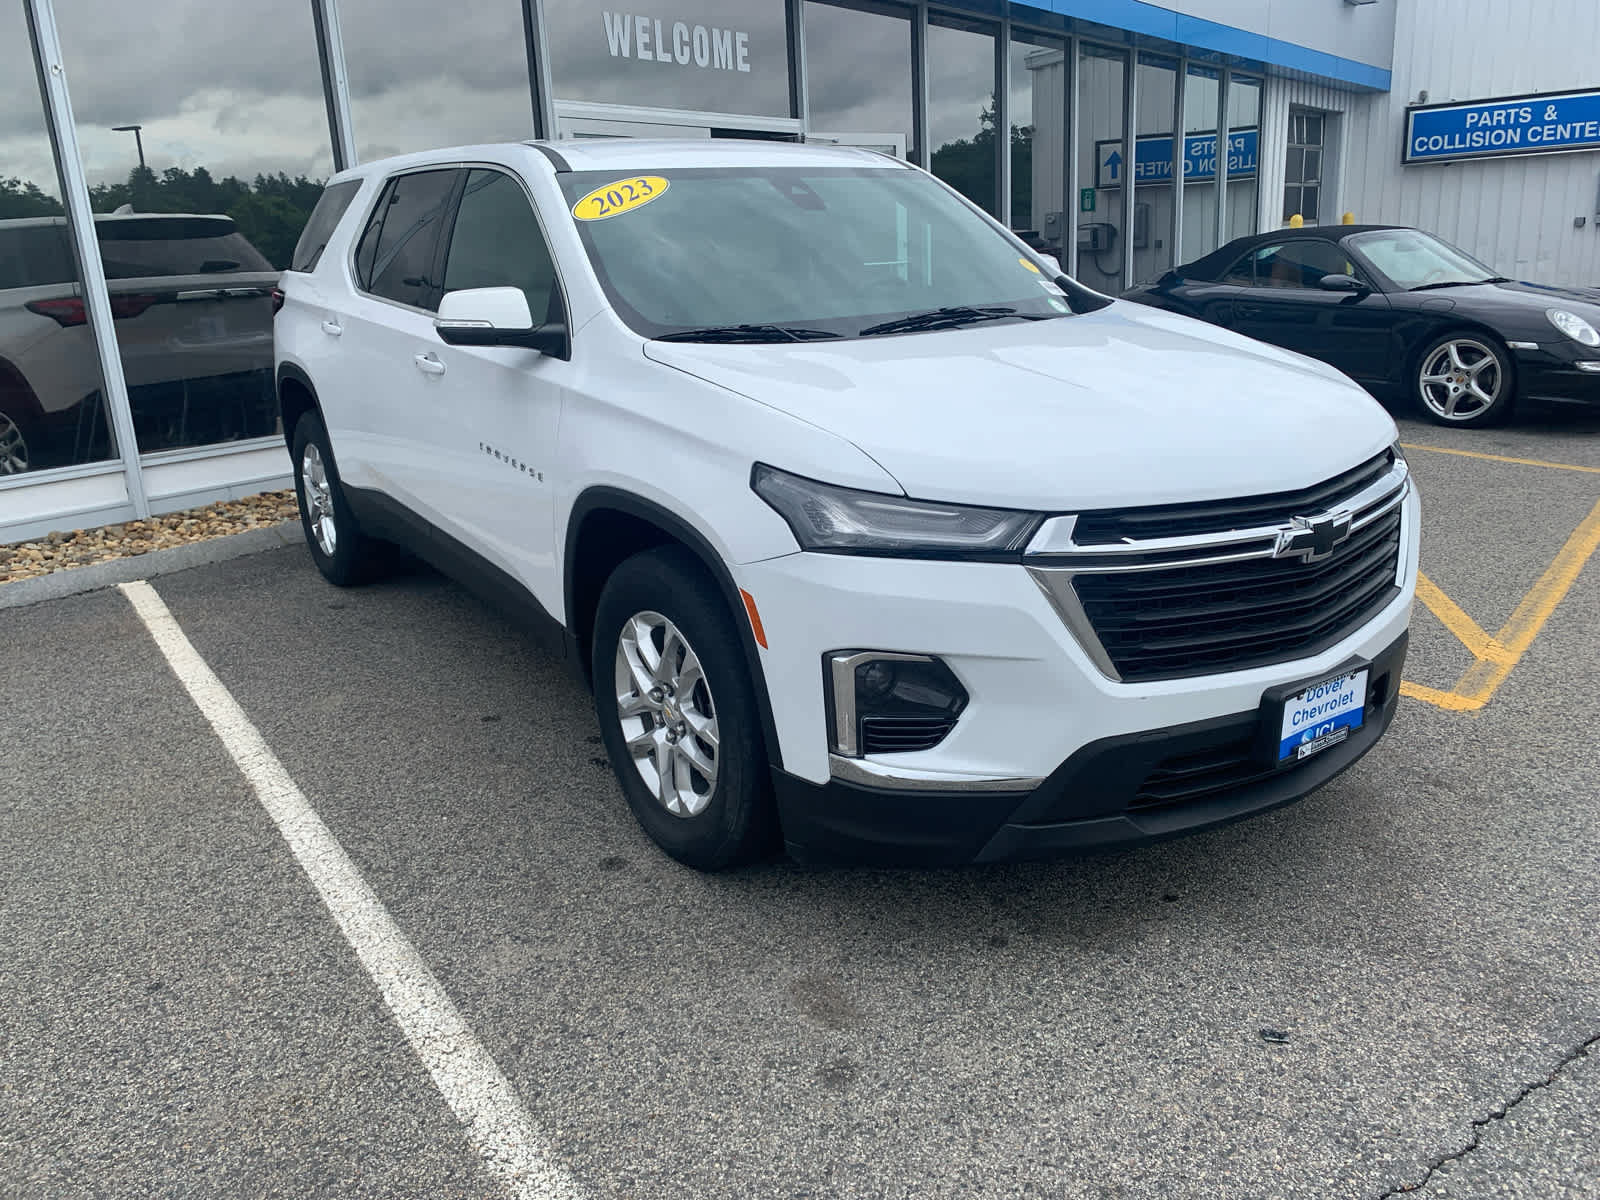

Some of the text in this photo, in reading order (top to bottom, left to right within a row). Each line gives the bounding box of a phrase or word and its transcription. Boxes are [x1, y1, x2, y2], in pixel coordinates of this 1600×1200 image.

[603, 11, 751, 72] WELCOME
[1466, 104, 1558, 128] PARTS &
[1414, 120, 1600, 152] COLLISION CENTE
[591, 179, 653, 215] 2023
[1292, 690, 1354, 726] Chevrolet
[1306, 679, 1345, 703] Dover
